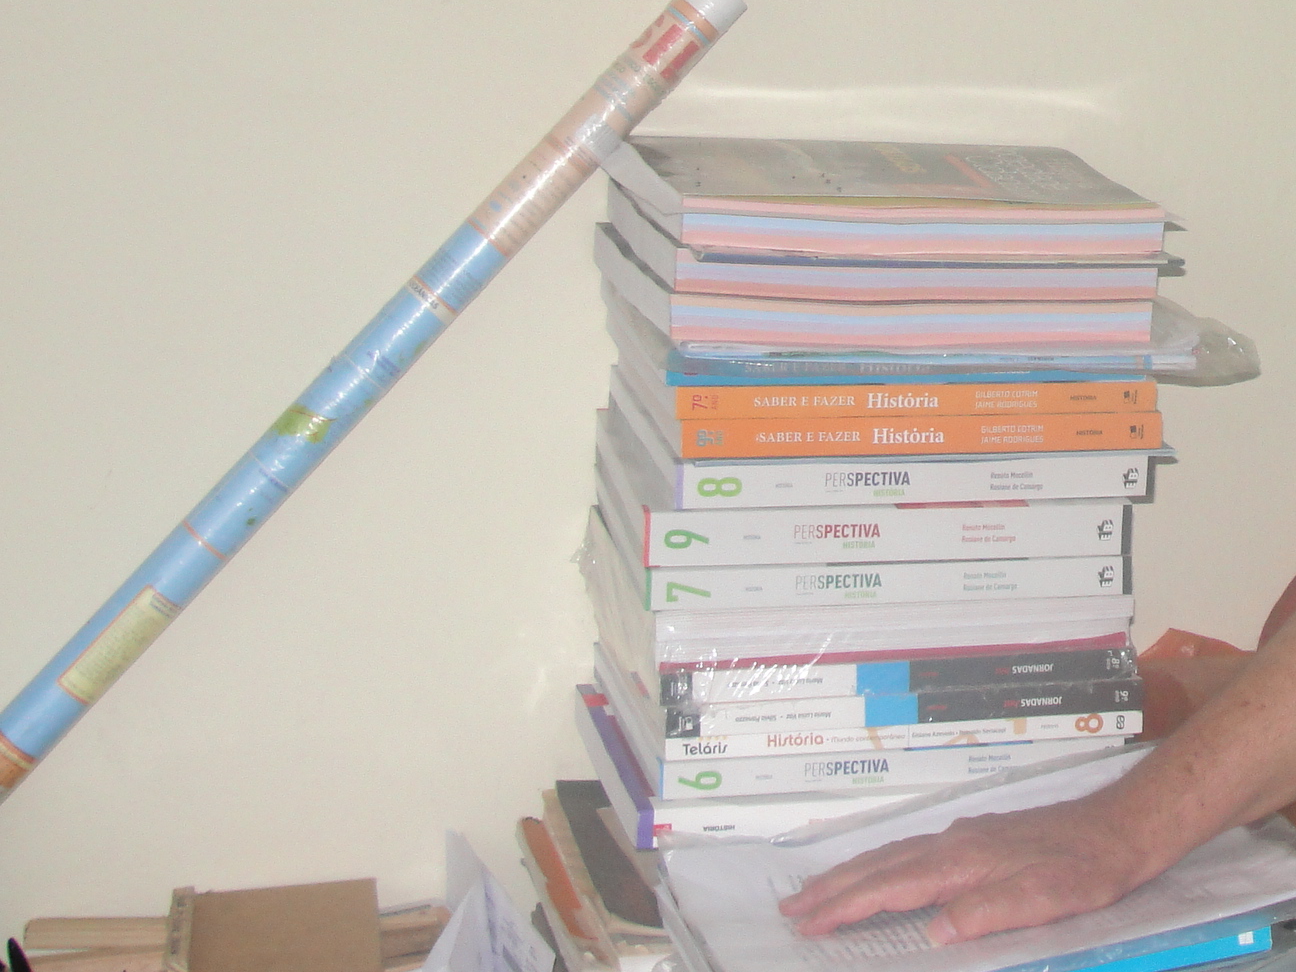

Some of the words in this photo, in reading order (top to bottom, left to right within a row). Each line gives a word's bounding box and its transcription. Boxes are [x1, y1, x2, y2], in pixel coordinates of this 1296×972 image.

[753, 396, 797, 407] SABER
[801, 396, 809, 406] E
[813, 395, 856, 406] FAZER
[867, 392, 939, 409] História
[975, 390, 1009, 399] GILBERTO
[1011, 390, 1038, 398] COTRIM
[975, 401, 994, 409] JAIME
[996, 400, 1038, 408] RODRIGUES
[758, 431, 802, 442] SABER
[806, 431, 815, 442] E
[819, 430, 861, 442] FAZER
[872, 427, 945, 444] História
[980, 425, 1015, 434] GILBERTO
[1017, 425, 1044, 433] COTRIM
[981, 436, 1001, 444] JAIME
[1003, 435, 1044, 443] RODRIGUES
[825, 471, 911, 487] PERSPECTIVA
[697, 477, 743, 497] 8
[872, 489, 905, 497] HISTÓRIA
[793, 523, 881, 539] PERSPECTIVA
[664, 529, 710, 549] 9
[842, 540, 876, 549] HISTÓRIA
[795, 573, 882, 590] PERSPECTIVA
[665, 581, 712, 603] 7
[844, 590, 877, 599] HISTÓRIA
[1012, 663, 1054, 674] JORNADAS
[1020, 696, 1062, 707] JORNADAS
[1074, 713, 1104, 734] 8
[767, 732, 824, 748] História
[682, 742, 728, 756] Teláris
[804, 758, 890, 777] PERSPECTIVA
[678, 771, 723, 791] 6
[852, 776, 885, 785] HISTÓRIA
[703, 824, 735, 832] HISTÓRIA
